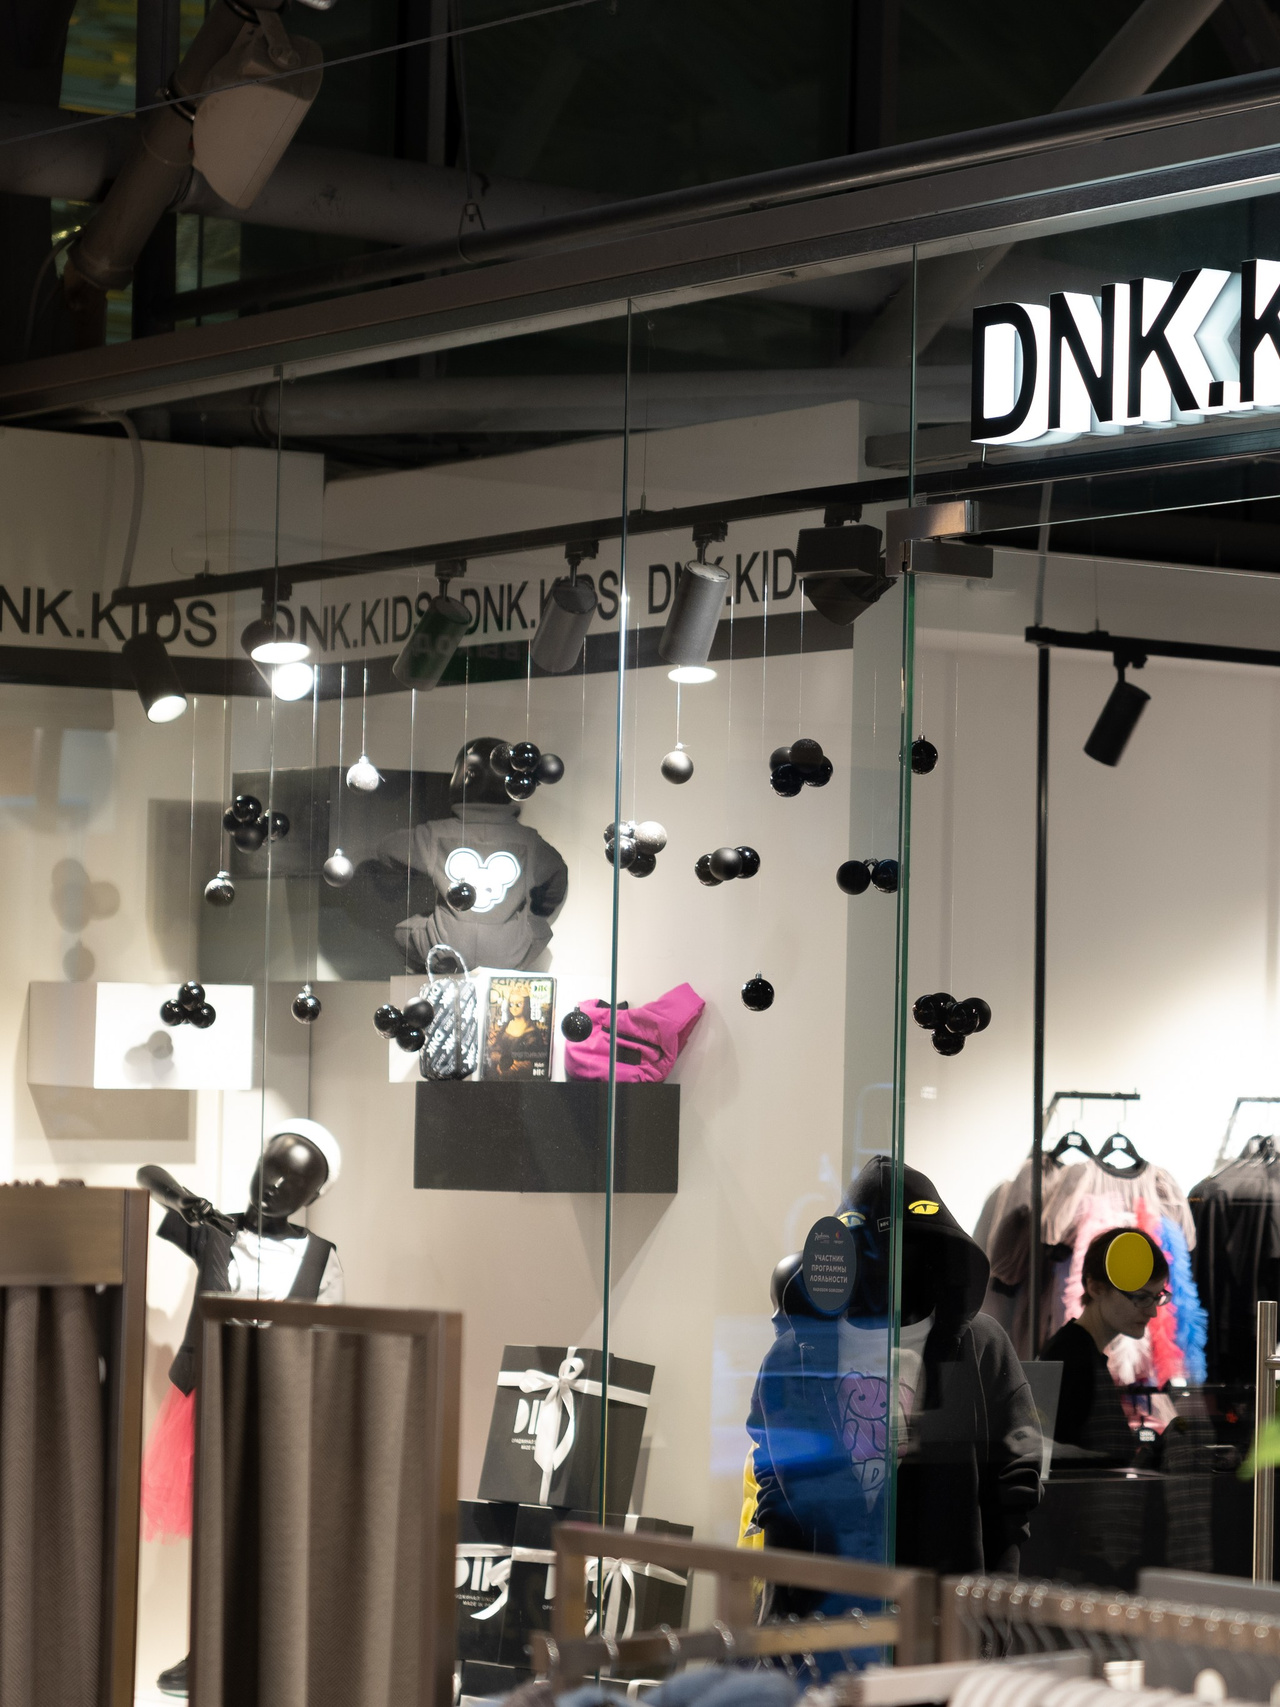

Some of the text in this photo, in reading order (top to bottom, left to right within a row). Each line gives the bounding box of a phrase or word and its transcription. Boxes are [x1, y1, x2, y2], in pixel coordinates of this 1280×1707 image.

[814, 1254, 844, 1262] УЧАСТНИК
[811, 1264, 847, 1273] ПРОГРАММЫ
[809, 1274, 848, 1284] ЛОЯЛЬНОСТИ
